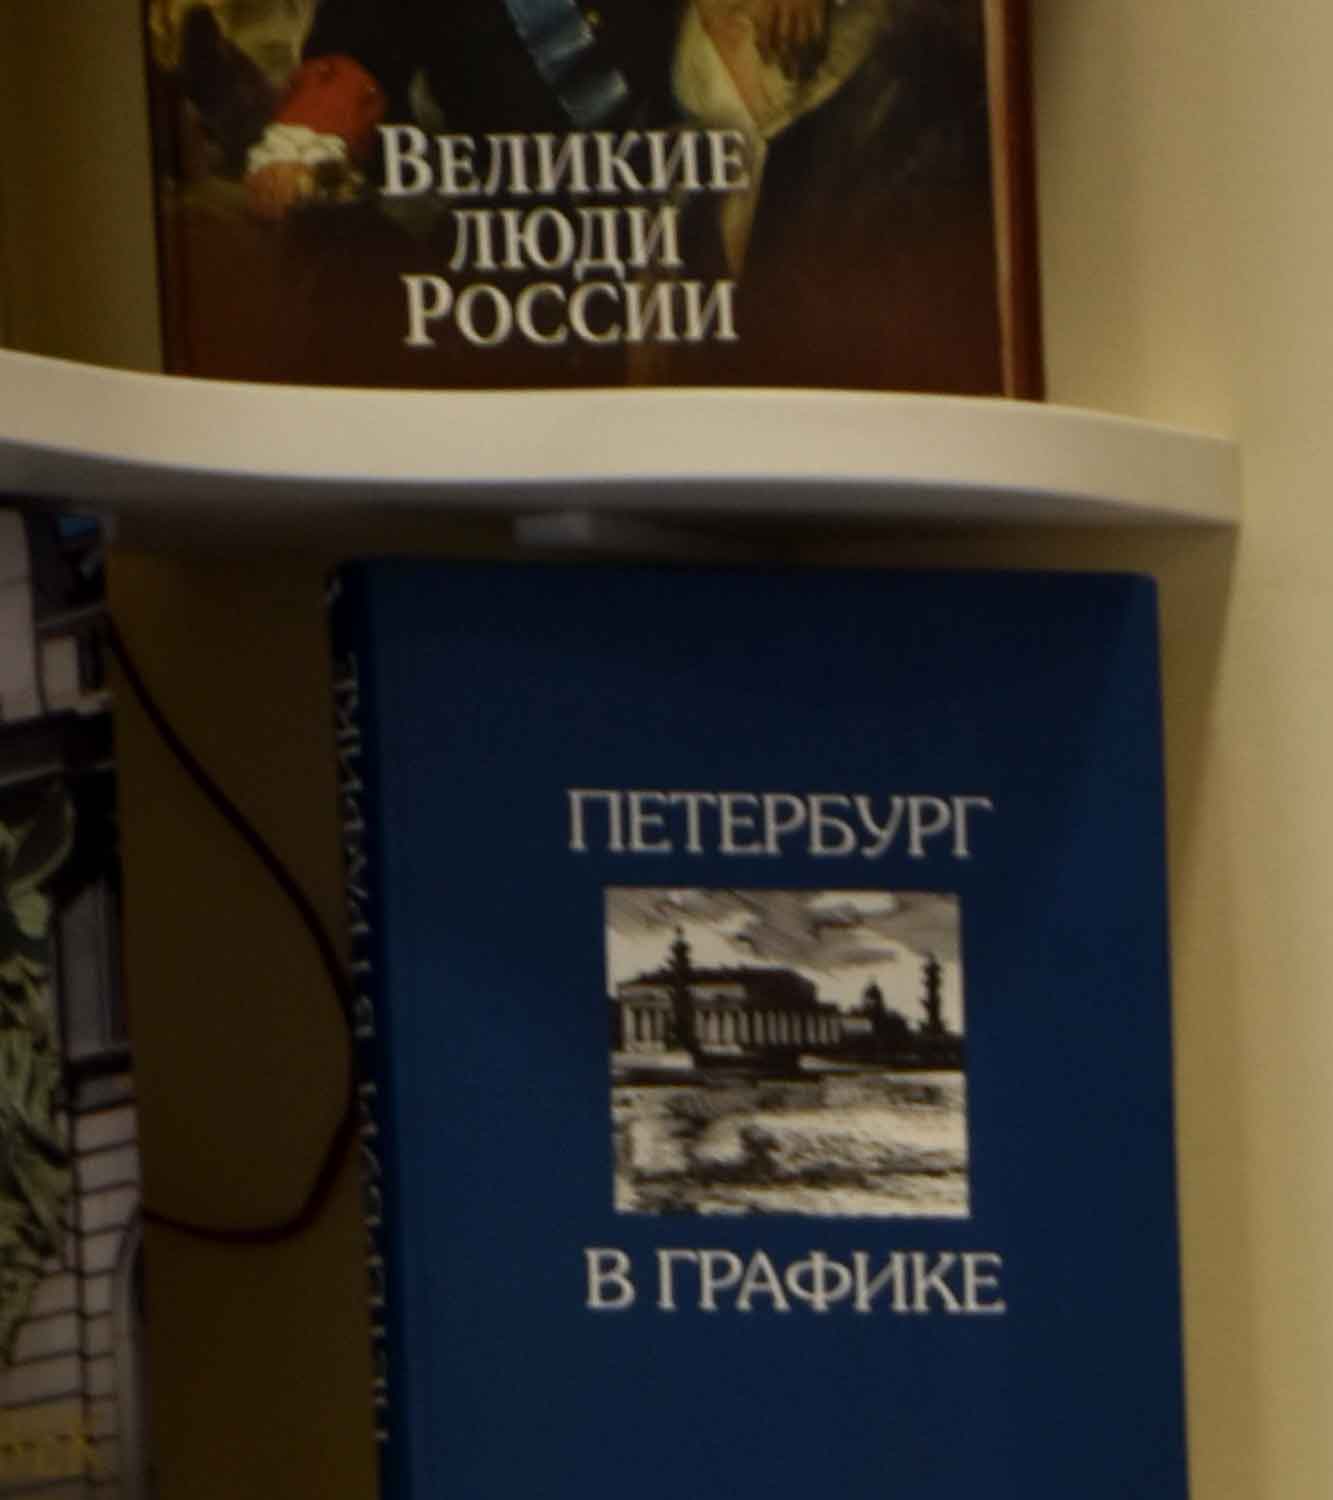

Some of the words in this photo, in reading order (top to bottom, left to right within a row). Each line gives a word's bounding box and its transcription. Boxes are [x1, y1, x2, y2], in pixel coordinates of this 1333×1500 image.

[378, 124, 750, 196] ВЕЛИКИЕ
[449, 205, 685, 282] ЛЮДИ
[400, 272, 740, 347] РОССИИ
[566, 788, 993, 859] ПЕТЕРБУРГ
[584, 1247, 636, 1311] В
[655, 1248, 1007, 1316] ГРАФИКЕ
